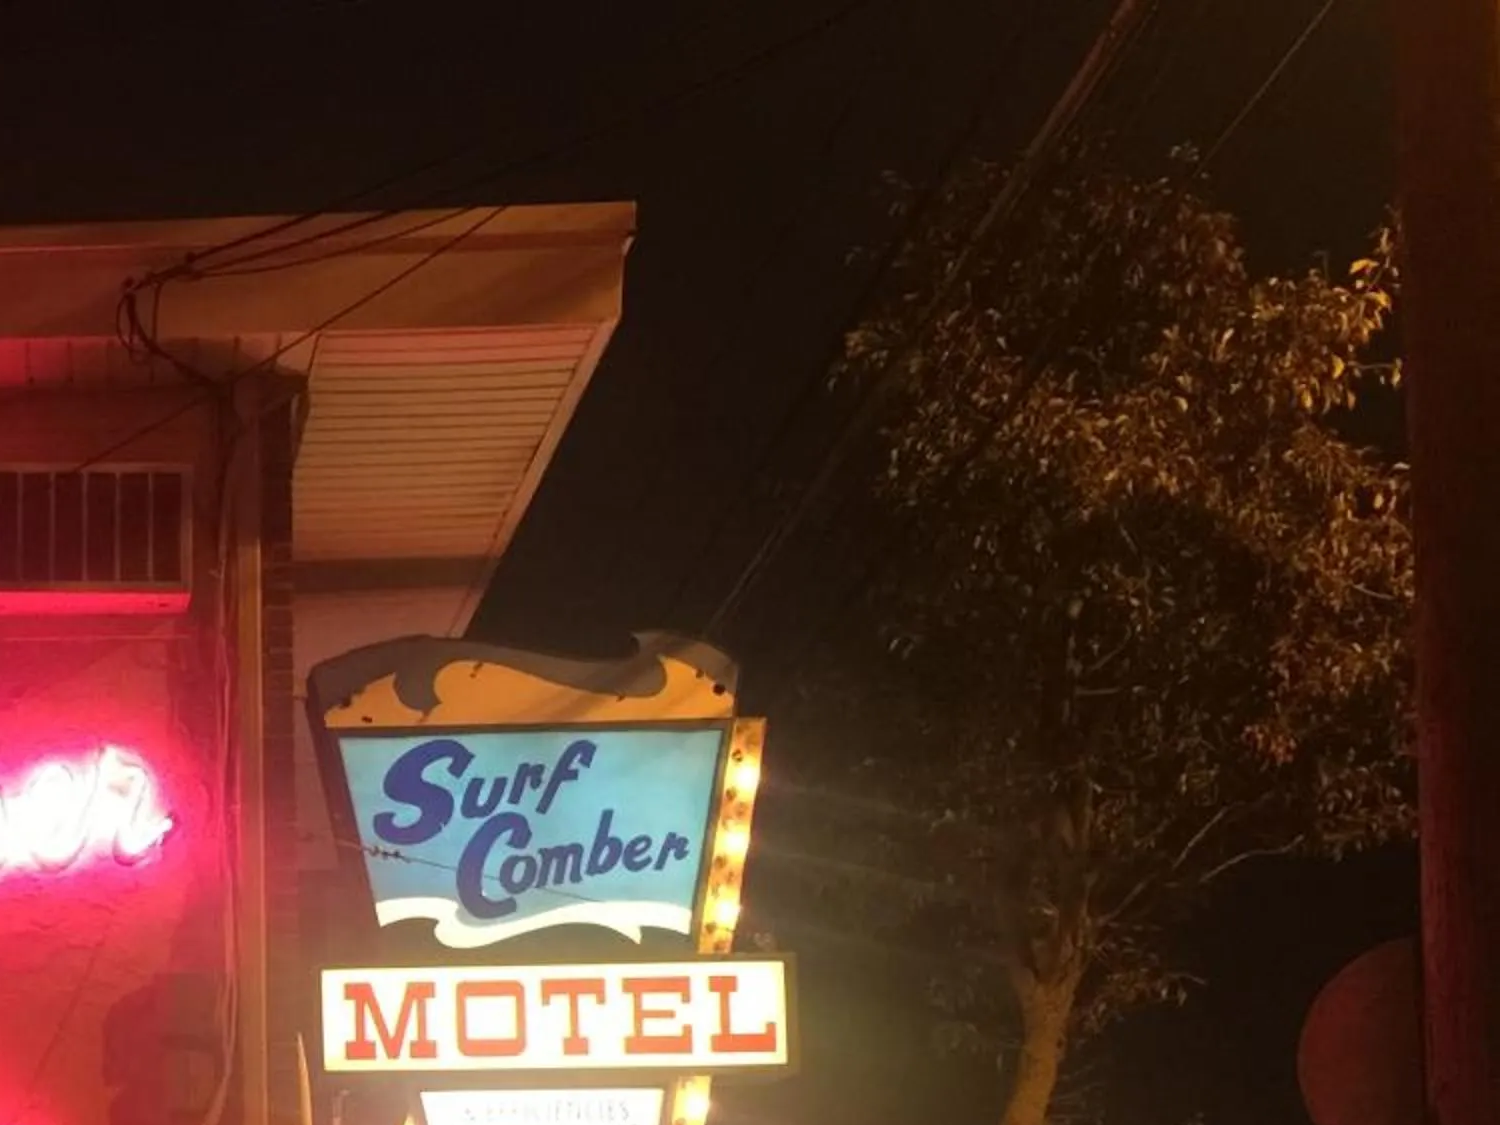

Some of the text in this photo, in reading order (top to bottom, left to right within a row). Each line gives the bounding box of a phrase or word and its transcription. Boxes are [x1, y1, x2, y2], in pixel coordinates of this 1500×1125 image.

[372, 738, 597, 846] Surf
[455, 808, 690, 920] Comber
[343, 975, 778, 1060] MOTEL
